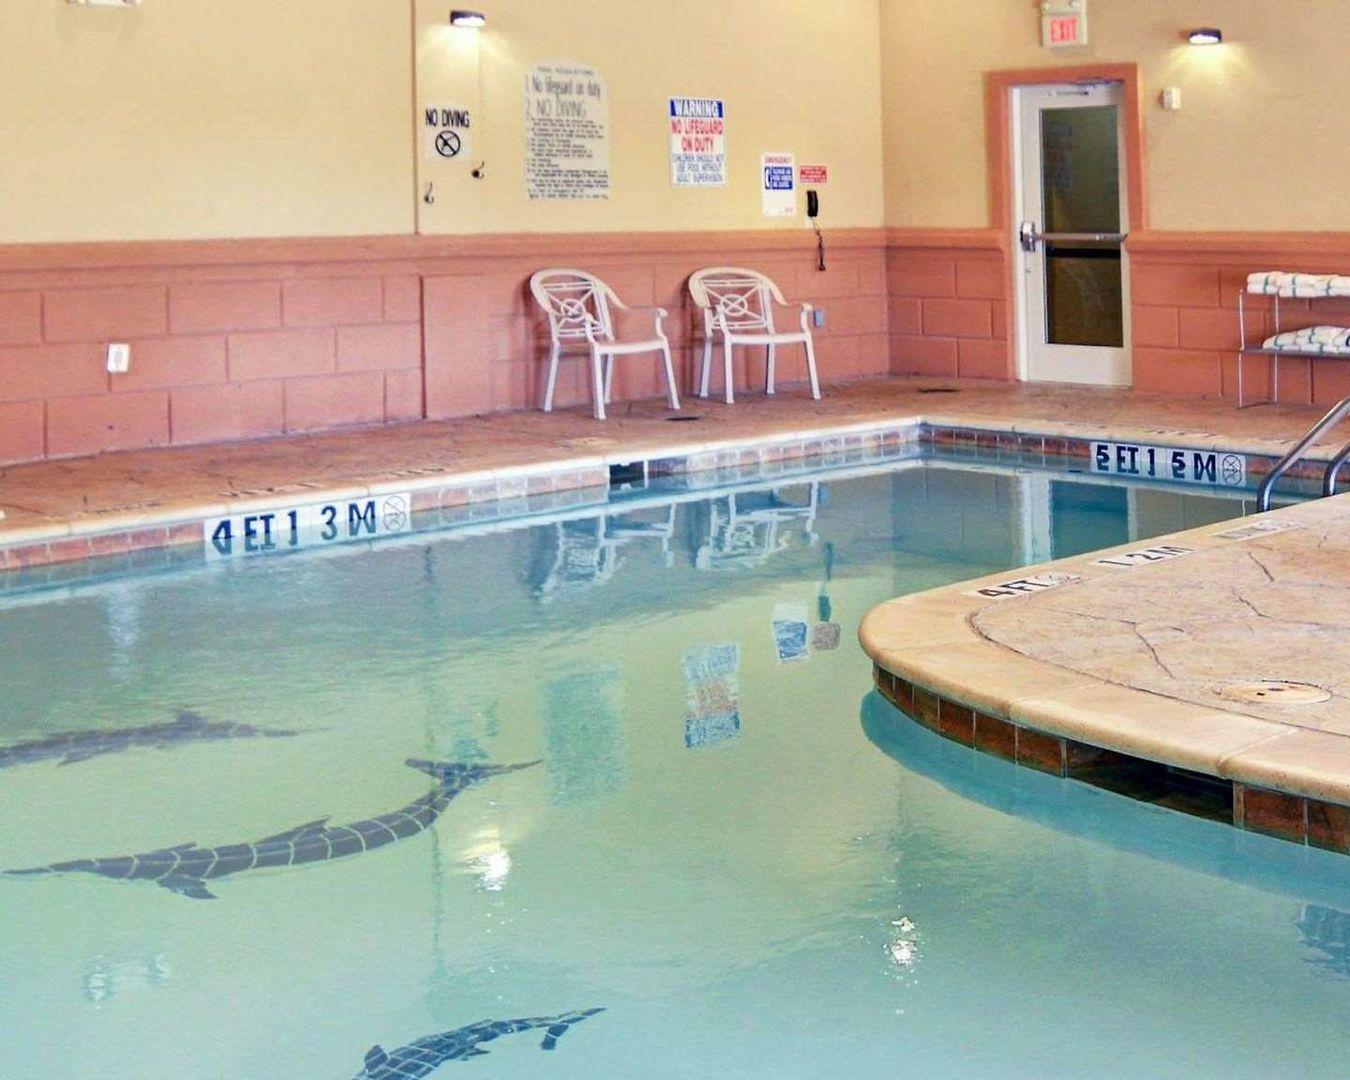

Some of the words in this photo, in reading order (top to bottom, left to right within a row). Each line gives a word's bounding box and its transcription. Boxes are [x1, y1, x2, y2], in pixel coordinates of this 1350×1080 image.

[1050, 18, 1078, 42] EXIT
[674, 100, 718, 117] WARNING
[425, 108, 438, 126] NO
[441, 109, 470, 128] DIVING
[671, 119, 681, 134] NO
[684, 119, 723, 135] LIFEGUARD
[682, 137, 692, 152] ON
[694, 137, 714, 153] DUTY
